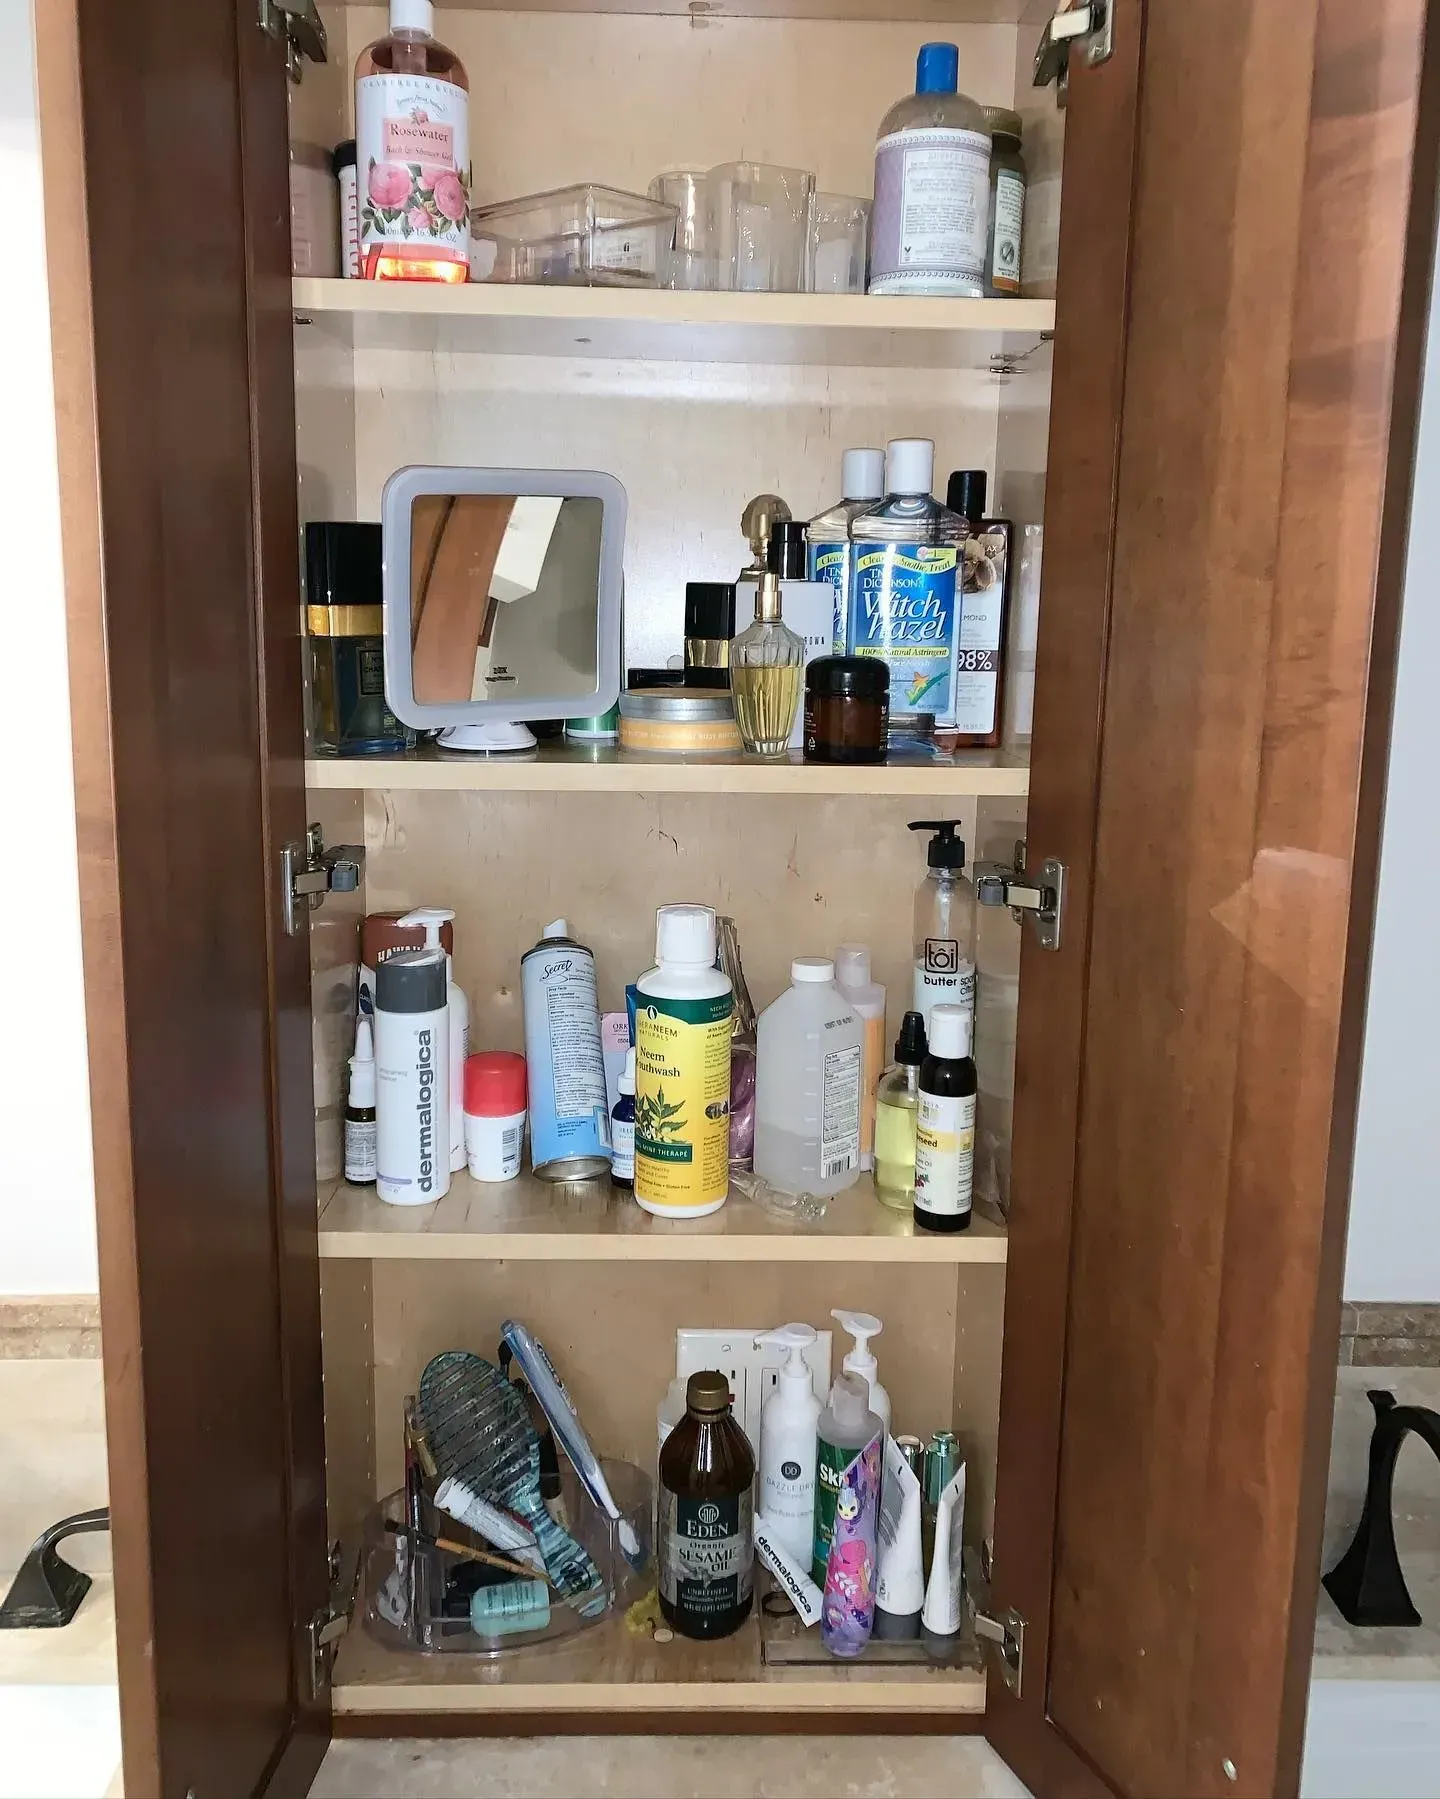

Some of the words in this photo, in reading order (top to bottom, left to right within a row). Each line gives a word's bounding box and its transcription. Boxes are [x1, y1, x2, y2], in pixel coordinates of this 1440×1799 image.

[390, 123, 449, 143] Rosewater
[862, 590, 942, 619] Witch
[868, 611, 947, 643] hazel
[913, 648, 947, 657] Astringent
[928, 943, 955, 969] tôi
[542, 960, 573, 979] Secret
[923, 975, 957, 987] butter
[640, 1045, 665, 1062] Neem
[638, 1061, 681, 1078] outhwash
[416, 1029, 433, 1193] dermalogica
[687, 1520, 729, 1538] EDEN
[689, 1541, 724, 1550] Organic
[679, 1547, 736, 1564] SESAME
[711, 1561, 730, 1572] OIL
[758, 1536, 812, 1614] dermalogica
